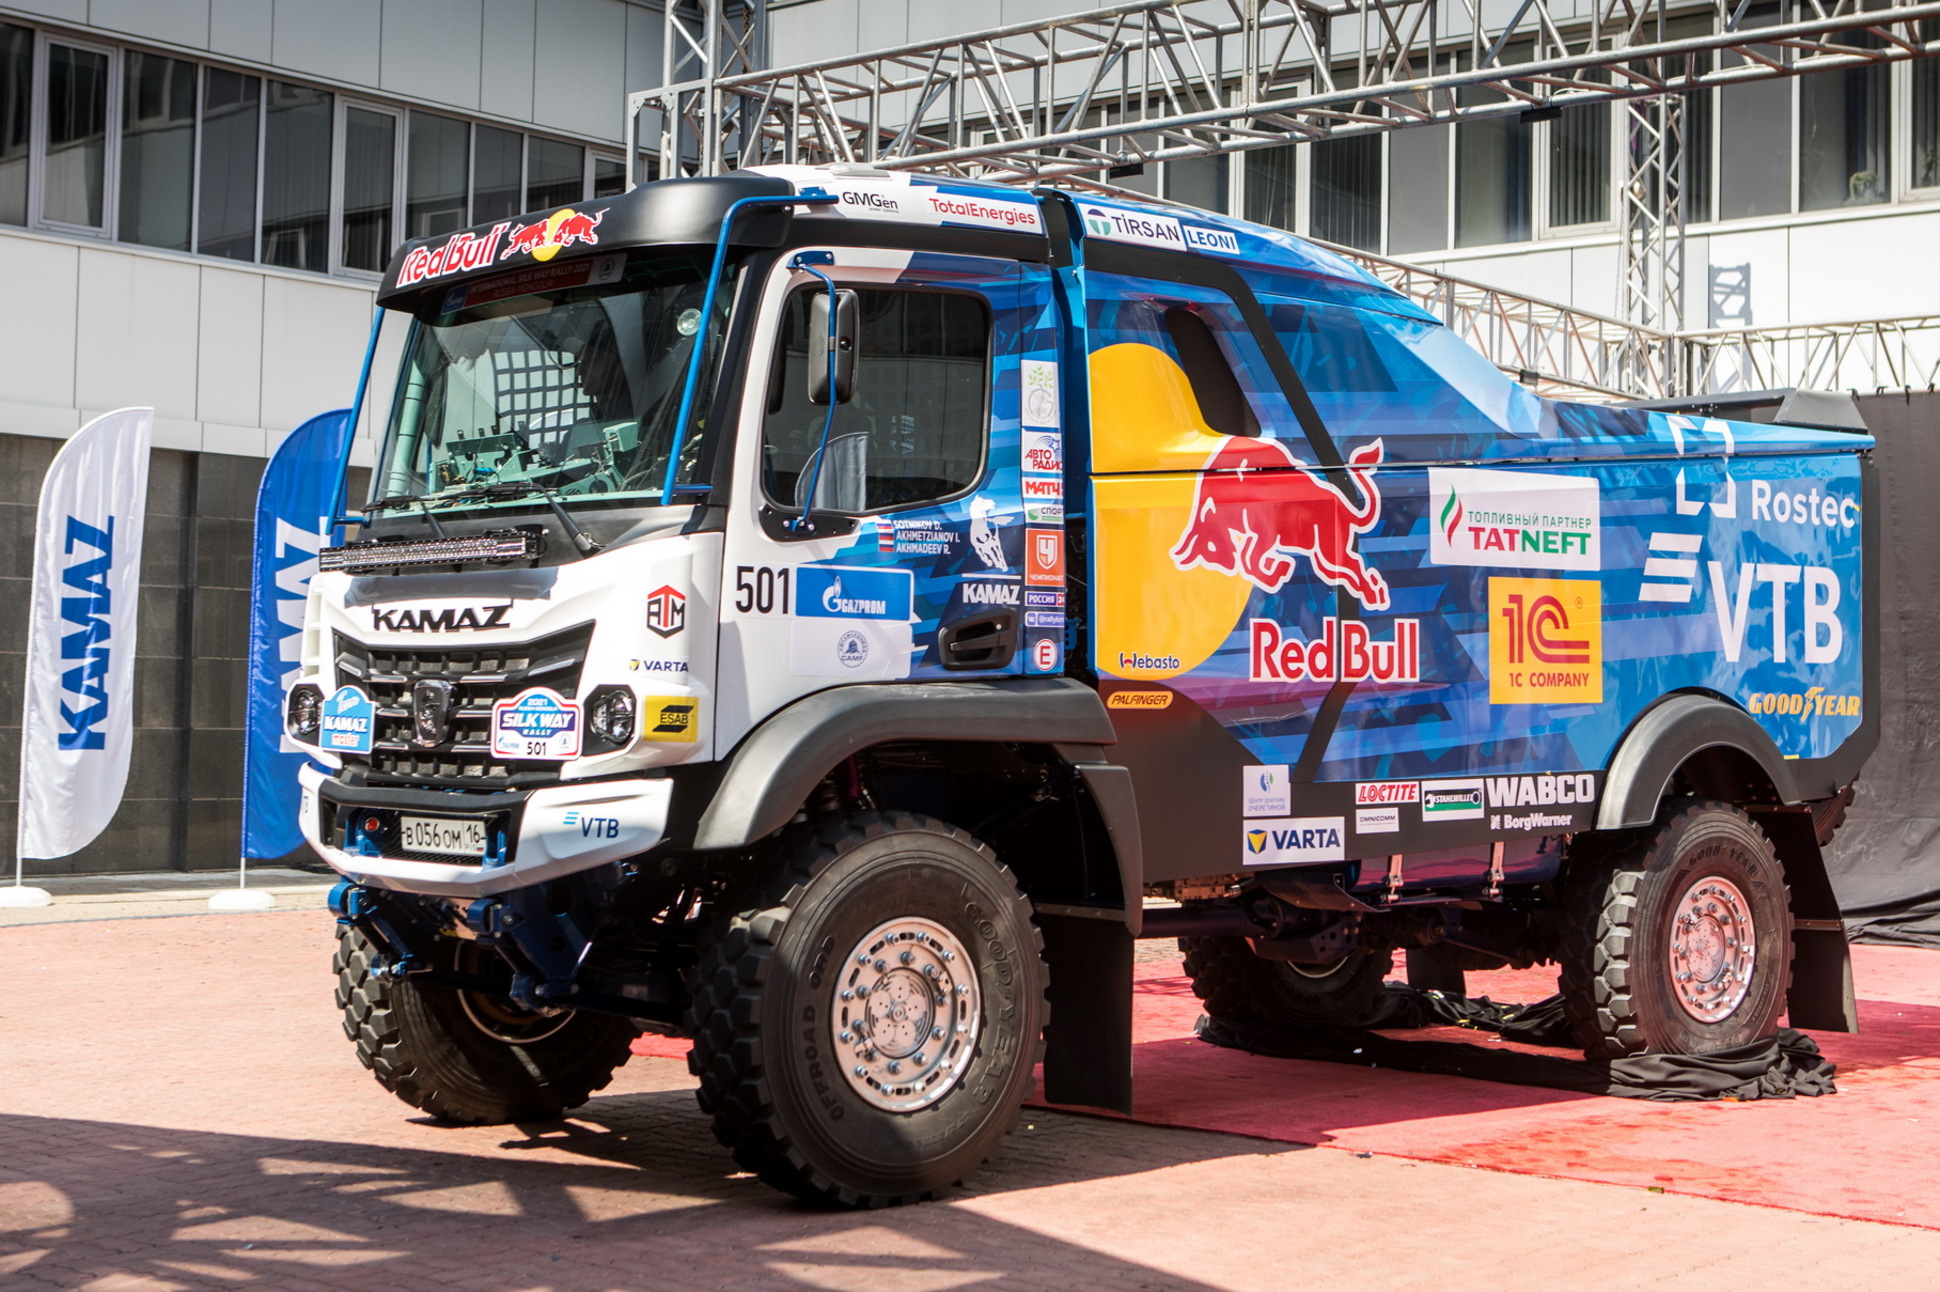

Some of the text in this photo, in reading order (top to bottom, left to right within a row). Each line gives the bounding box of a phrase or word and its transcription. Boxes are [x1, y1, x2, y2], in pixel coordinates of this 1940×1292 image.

[842, 191, 899, 210] GMGen
[929, 198, 1035, 225] TotalEnergies
[1188, 229, 1236, 251] LEONI
[395, 221, 512, 289] Red Bull
[518, 272, 534, 284] SILK
[533, 269, 550, 281] WAY
[551, 265, 573, 277] RALLY
[1025, 449, 1052, 459] АВТО
[1752, 479, 1856, 528] Rostec
[1468, 511, 1592, 529] ТОПЛИВНЫЙ ПАРТНЕР
[896, 530, 954, 542] AKHMETZIANOV
[1468, 526, 1592, 555] TATNEFT
[896, 543, 951, 555] AKHMADEEV R.
[1030, 574, 1065, 582] ЧЕМПИОНАТ
[735, 565, 790, 615] 501
[963, 583, 1020, 605] KAMAZ
[841, 598, 886, 614] GAZPROM
[1029, 595, 1055, 604] РОССИЯ
[372, 604, 513, 633] KAMAZ
[1707, 561, 1843, 664] VTB
[58, 514, 115, 750] KAMAZ
[1040, 646, 1050, 664] E
[1249, 616, 1420, 683] Red Bull
[644, 660, 689, 672] VARTA
[1119, 652, 1180, 669] Webasto
[1529, 672, 1590, 688] COMPANY
[1111, 694, 1168, 705] PALFINGER
[324, 715, 368, 733] KAMAZ
[501, 713, 574, 728] SILK WAY
[660, 713, 688, 724] ESAB
[527, 741, 546, 756] 501
[1358, 784, 1417, 802] LOCTITE
[1486, 774, 1595, 808] WABCO
[581, 816, 619, 839] VTB
[1360, 815, 1396, 823] OMNICOMM
[1504, 812, 1572, 831] BorgWarner
[466, 824, 480, 844] 16
[1272, 828, 1341, 850] VARTA
